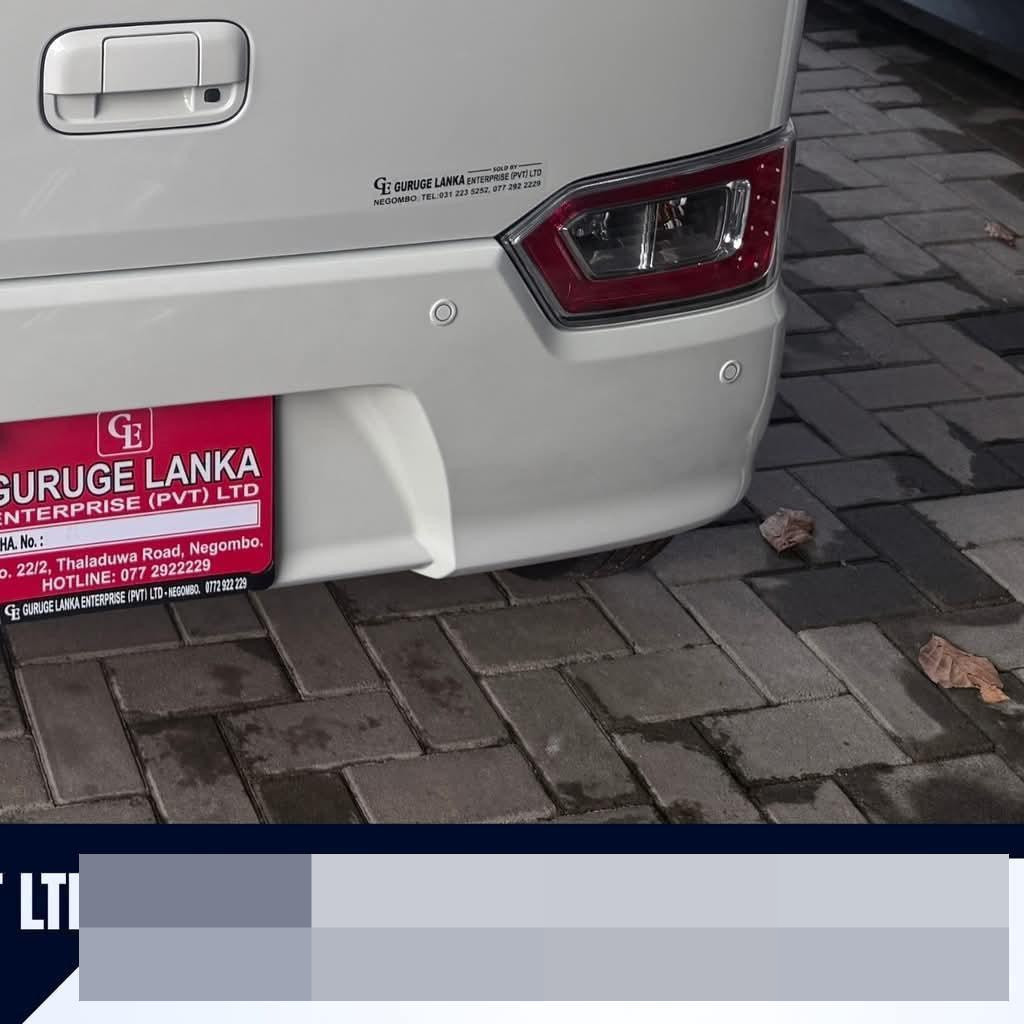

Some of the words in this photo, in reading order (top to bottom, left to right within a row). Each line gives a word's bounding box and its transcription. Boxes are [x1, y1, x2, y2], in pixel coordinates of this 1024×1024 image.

[394, 178, 432, 193] GURUGE
[434, 174, 465, 188] LANKA
[466, 172, 509, 185] ENTERPRISE
[510, 170, 527, 182] (PVT)
[529, 168, 542, 178] LTD
[455, 188, 469, 197] 223
[493, 184, 507, 193] 077
[508, 182, 521, 191] 292
[523, 180, 542, 189] 2229
[145, 447, 262, 490] LANKA
[148, 487, 209, 509] (PVT)
[217, 483, 260, 501] LTD
[17, 560, 52, 577] 22/2,
[56, 548, 138, 572] Thaladuwa
[142, 544, 185, 562] Road,
[189, 535, 264, 558] Negombo.
[42, 570, 117, 592] HOTLINE:
[121, 567, 147, 582] 077
[151, 559, 211, 578] 2922229
[22, 600, 54, 616] GURUGE
[55, 596, 81, 613] LANKA
[81, 591, 126, 609] ENTERPRISE
[127, 588, 148, 605] (PVT)
[150, 586, 163, 600] LTD
[168, 584, 201, 598] NEGOMBO.
[205, 580, 221, 593] 0772
[222, 578, 234, 591] 922
[235, 577, 247, 589] 229
